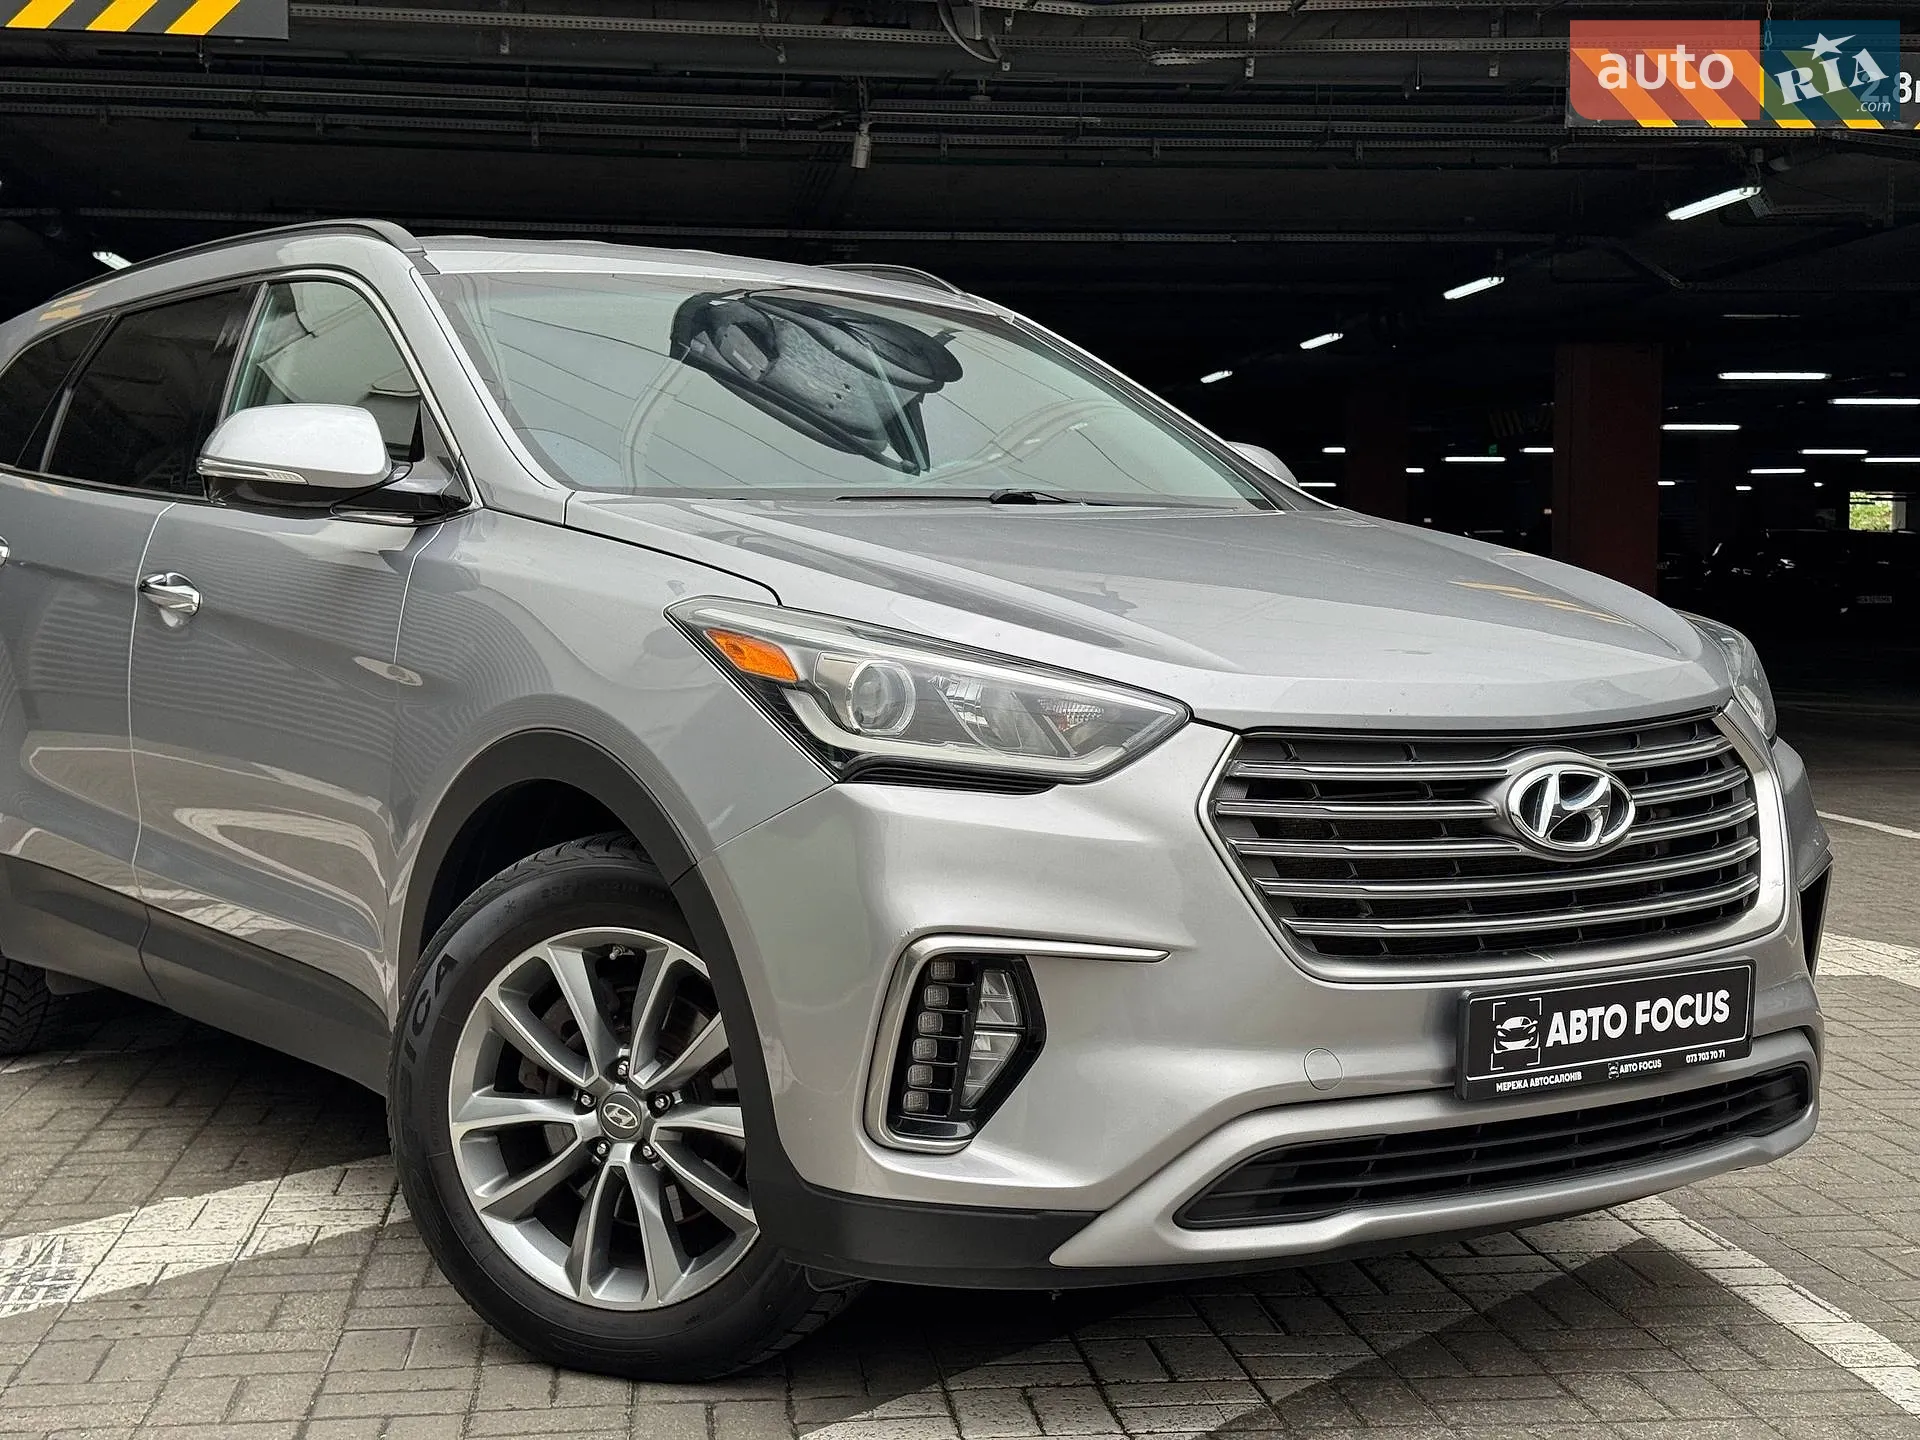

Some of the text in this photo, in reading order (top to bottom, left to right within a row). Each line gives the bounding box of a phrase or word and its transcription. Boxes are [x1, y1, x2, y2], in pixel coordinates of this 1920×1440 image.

[1635, 989, 1730, 1035] FOCUS
[1638, 1058, 1662, 1071] FOCUS
[1686, 1050, 1725, 1064] 073 703 70 71
[1496, 1071, 1582, 1092] МЕРЕЖА АВТОСАЛОНІВ
